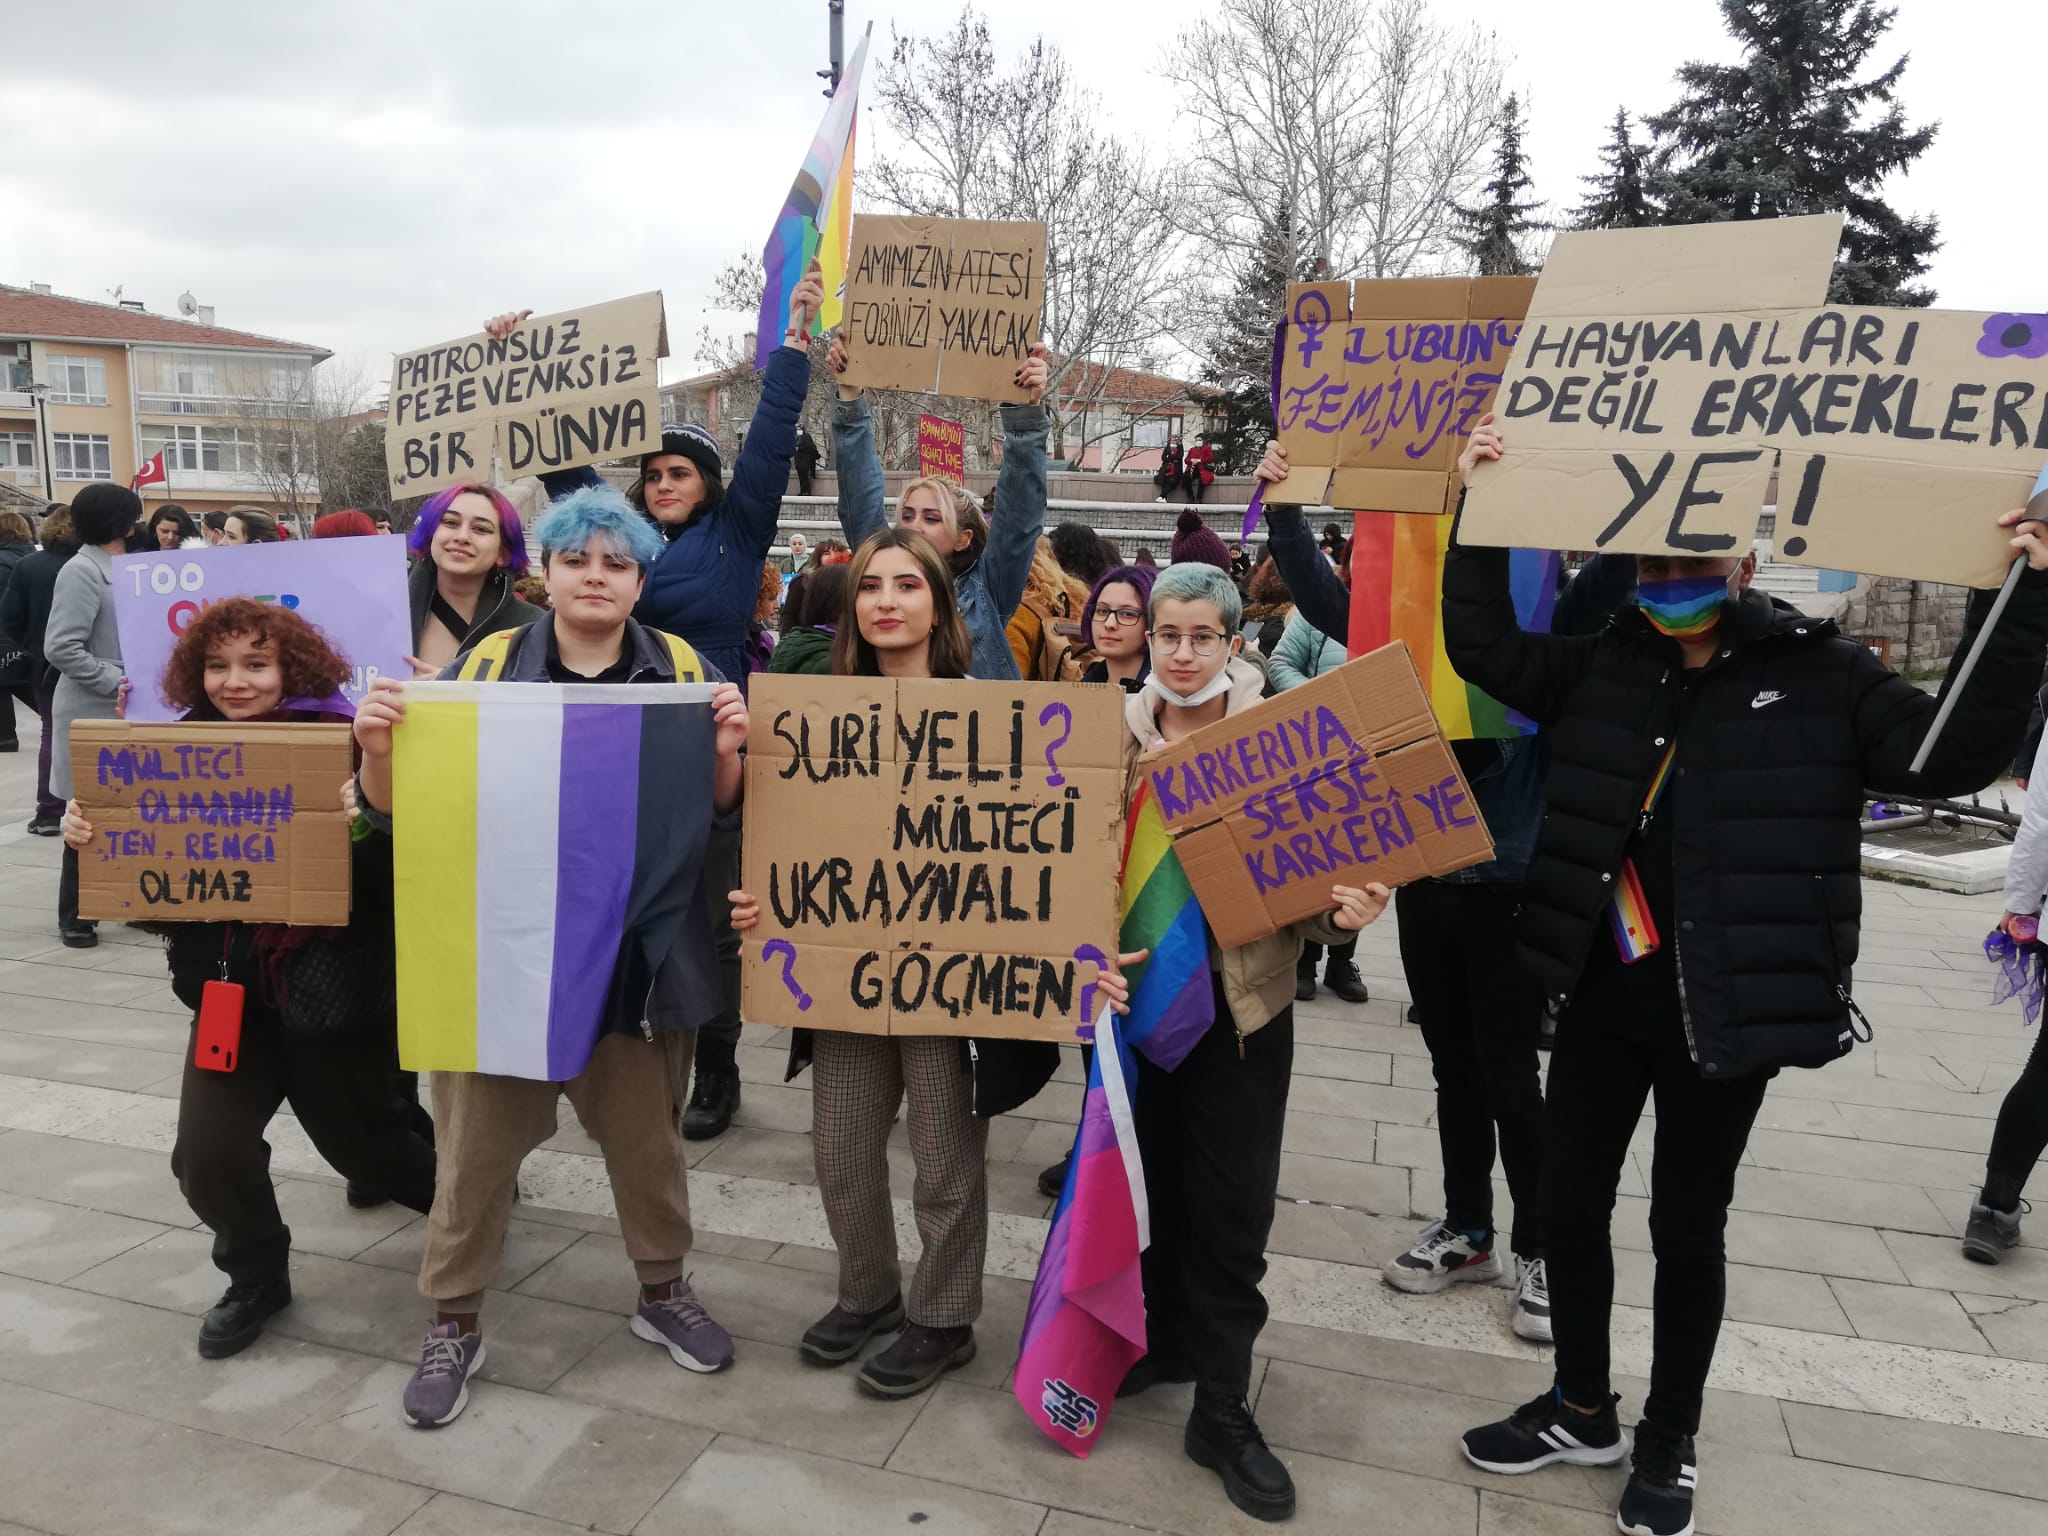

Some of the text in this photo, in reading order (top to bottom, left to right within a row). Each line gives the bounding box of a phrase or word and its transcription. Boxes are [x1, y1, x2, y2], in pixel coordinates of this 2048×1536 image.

[956, 248, 1033, 300] ATEŞİ
[398, 319, 580, 390] PATRONSUZ
[849, 297, 1034, 360] FOBİNİZİ YAKACAK
[1526, 311, 1919, 369] HAYVANLARI
[396, 344, 641, 425] PEZEVENKSİZ
[1504, 365, 1664, 435] DEĞİL
[404, 398, 646, 478] BİR DÜNYA
[125, 561, 205, 597] TOO
[1757, 690, 1781, 701] NIKE
[893, 786, 1081, 854] MÜLTECİ
[1414, 775, 1477, 833] YE
[139, 868, 253, 905] OLMAZ
[769, 857, 1053, 929] UKRAYNALI
[762, 938, 813, 1012] ?
